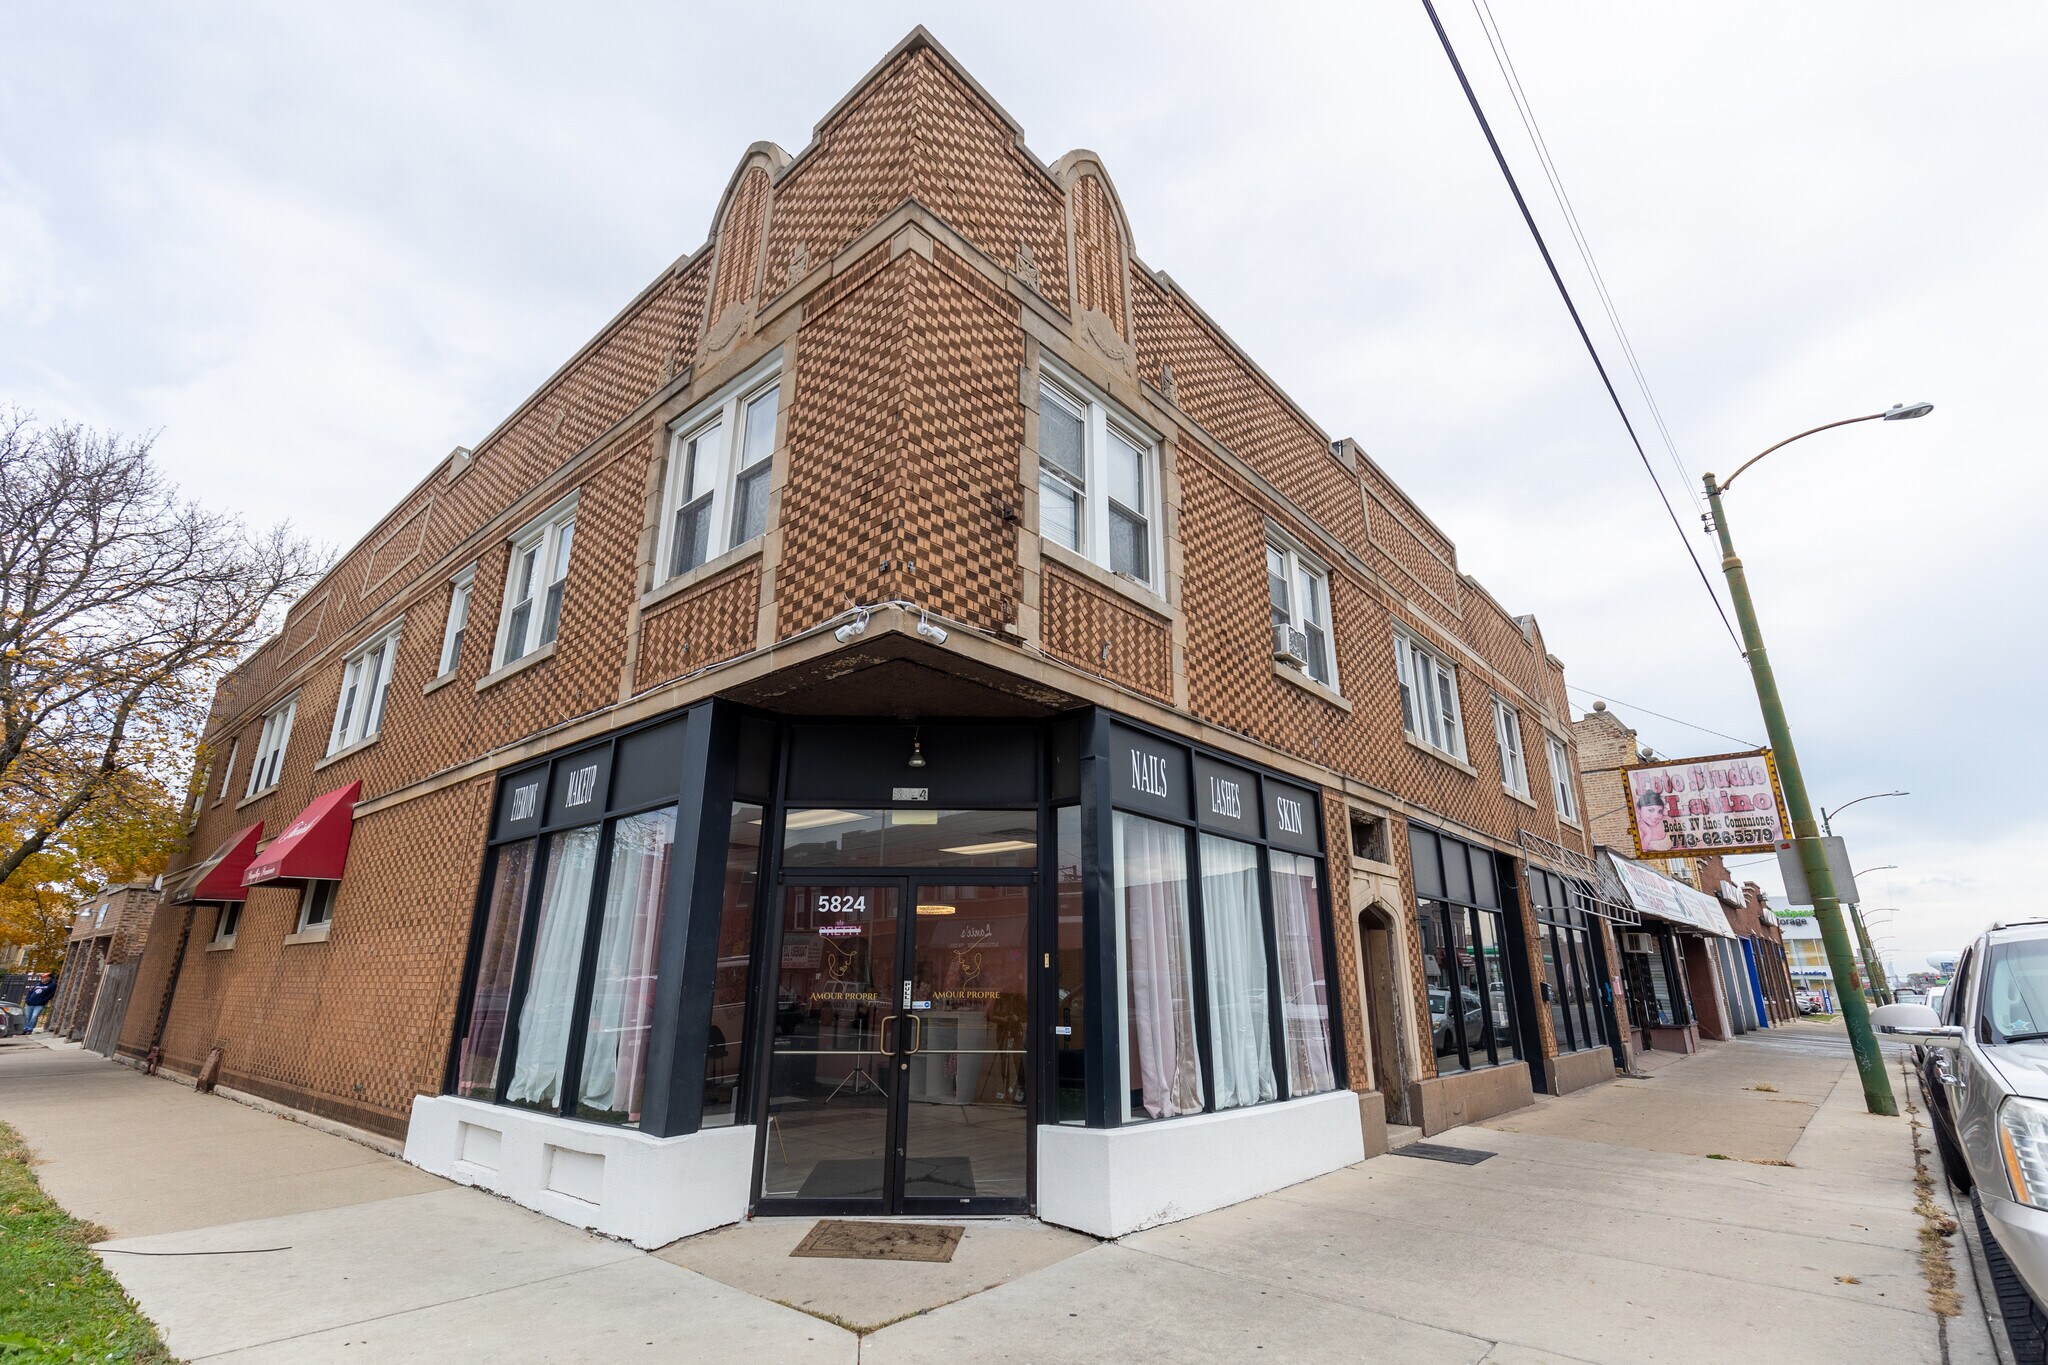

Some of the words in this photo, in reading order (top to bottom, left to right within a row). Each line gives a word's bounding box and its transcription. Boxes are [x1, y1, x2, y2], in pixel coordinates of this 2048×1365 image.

[565, 764, 597, 808] MAKEUP
[1131, 749, 1168, 798] NAILS
[1632, 769, 1685, 796] Foto
[1687, 761, 1767, 791] Studio
[510, 782, 539, 822] EYEBROWS
[1210, 776, 1241, 820] LASHES
[1664, 791, 1773, 817] Latino
[1277, 796, 1303, 835] SKIN
[1663, 820, 1687, 833] Bodas
[1689, 817, 1700, 831] XV
[1725, 815, 1775, 829] Comuniones
[818, 895, 866, 913] 5824
[1780, 918, 1808, 927] orage
[810, 992, 843, 1001] AMOUR
[932, 991, 965, 1000] AMOUR
[967, 991, 1000, 999] PROPRE
